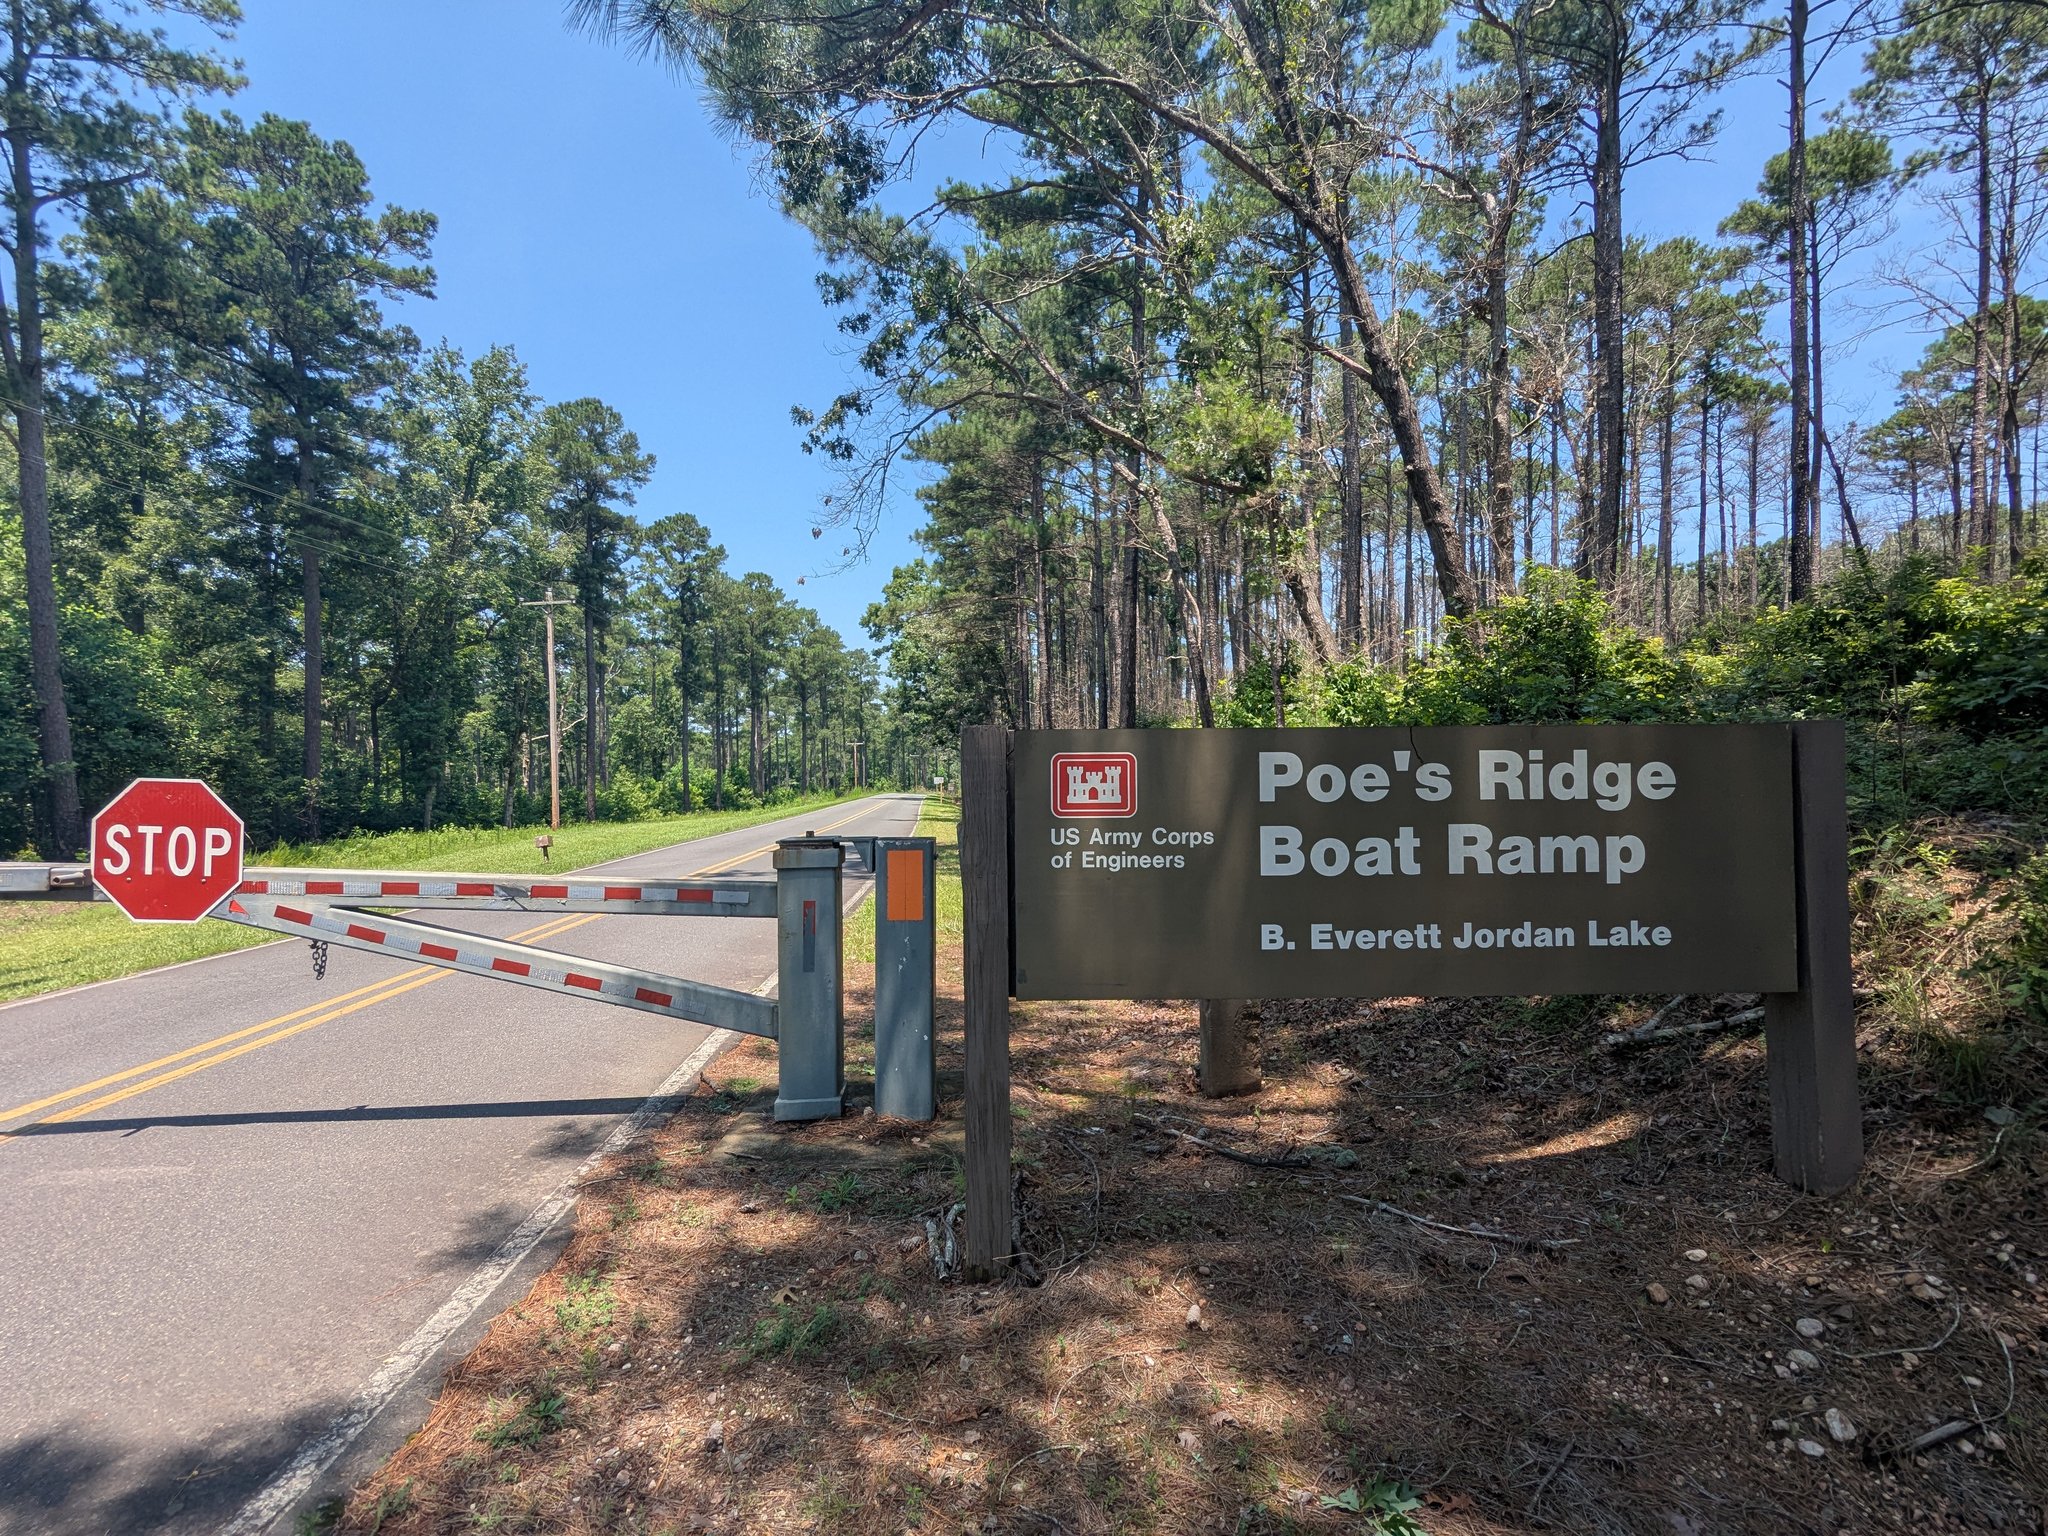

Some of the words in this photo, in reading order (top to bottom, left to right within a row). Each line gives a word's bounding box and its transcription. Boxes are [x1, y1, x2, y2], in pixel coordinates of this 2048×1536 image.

[1259, 750, 1453, 803] Poe's
[1479, 749, 1677, 812] Ridge
[103, 823, 232, 877] STOP
[1050, 828, 1081, 846] US
[1088, 827, 1143, 848] Army
[1151, 827, 1215, 847] Corps
[1260, 825, 1421, 877] Boat
[1448, 823, 1646, 885] Ramp
[1050, 851, 1073, 869] of
[1082, 851, 1185, 873] Engineers
[1260, 923, 1296, 950] B.
[1311, 923, 1442, 950] Everett
[1453, 921, 1575, 949] Jordan
[1589, 919, 1672, 947] Lake
